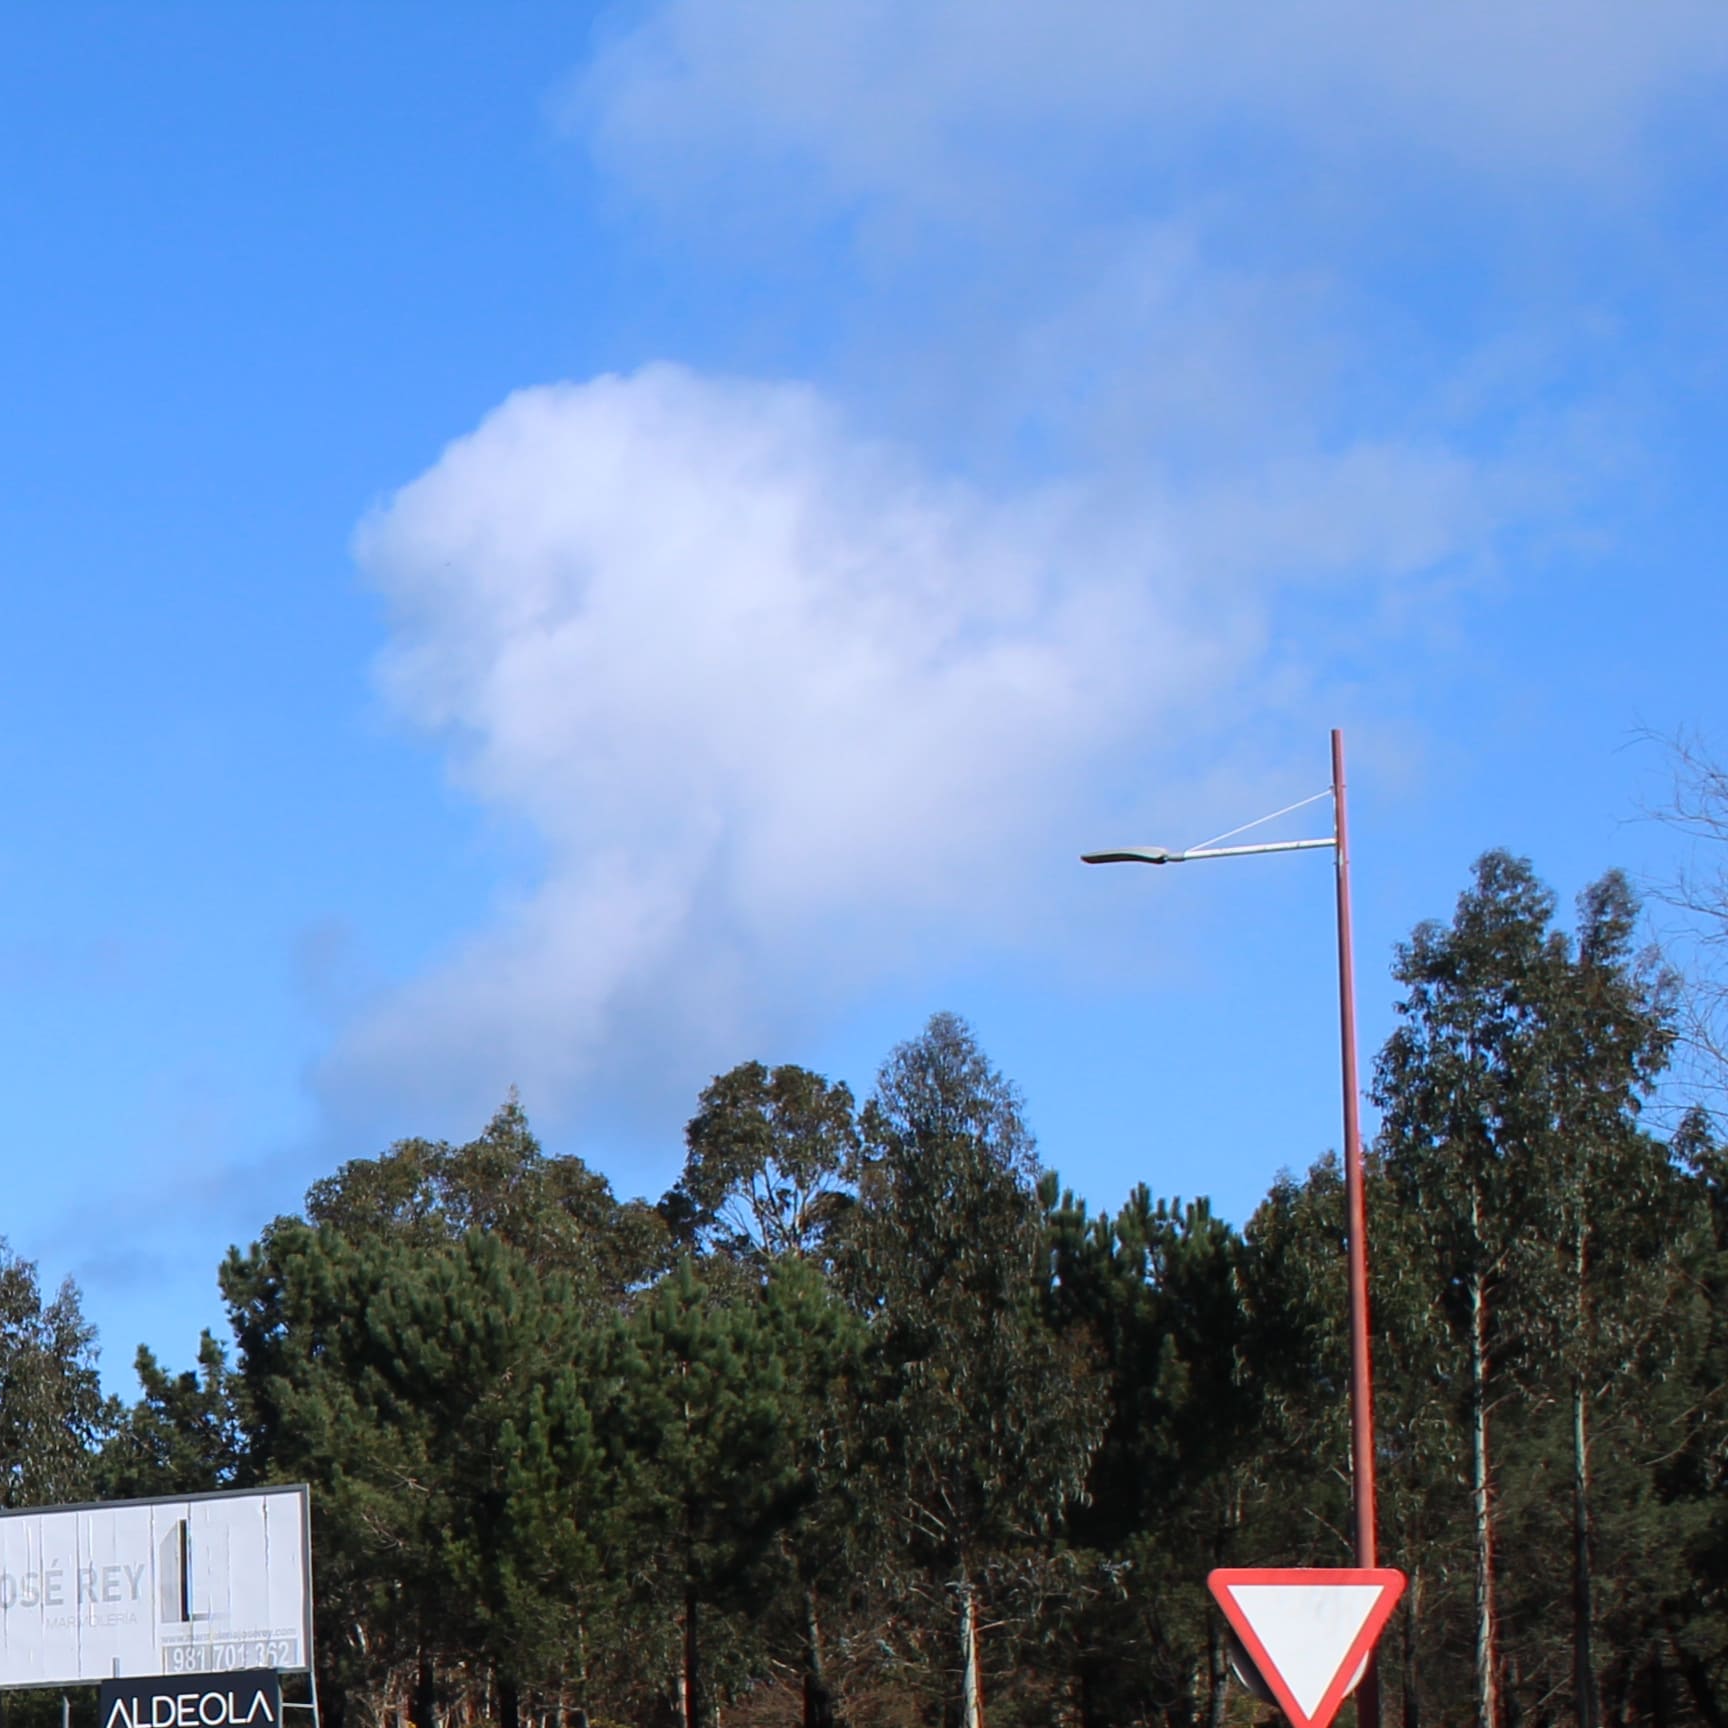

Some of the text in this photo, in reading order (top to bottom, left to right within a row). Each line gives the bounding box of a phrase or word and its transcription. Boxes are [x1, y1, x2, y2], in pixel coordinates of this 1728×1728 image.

[78, 1564, 145, 1604] REY
[173, 1641, 289, 1672] 981 701 362
